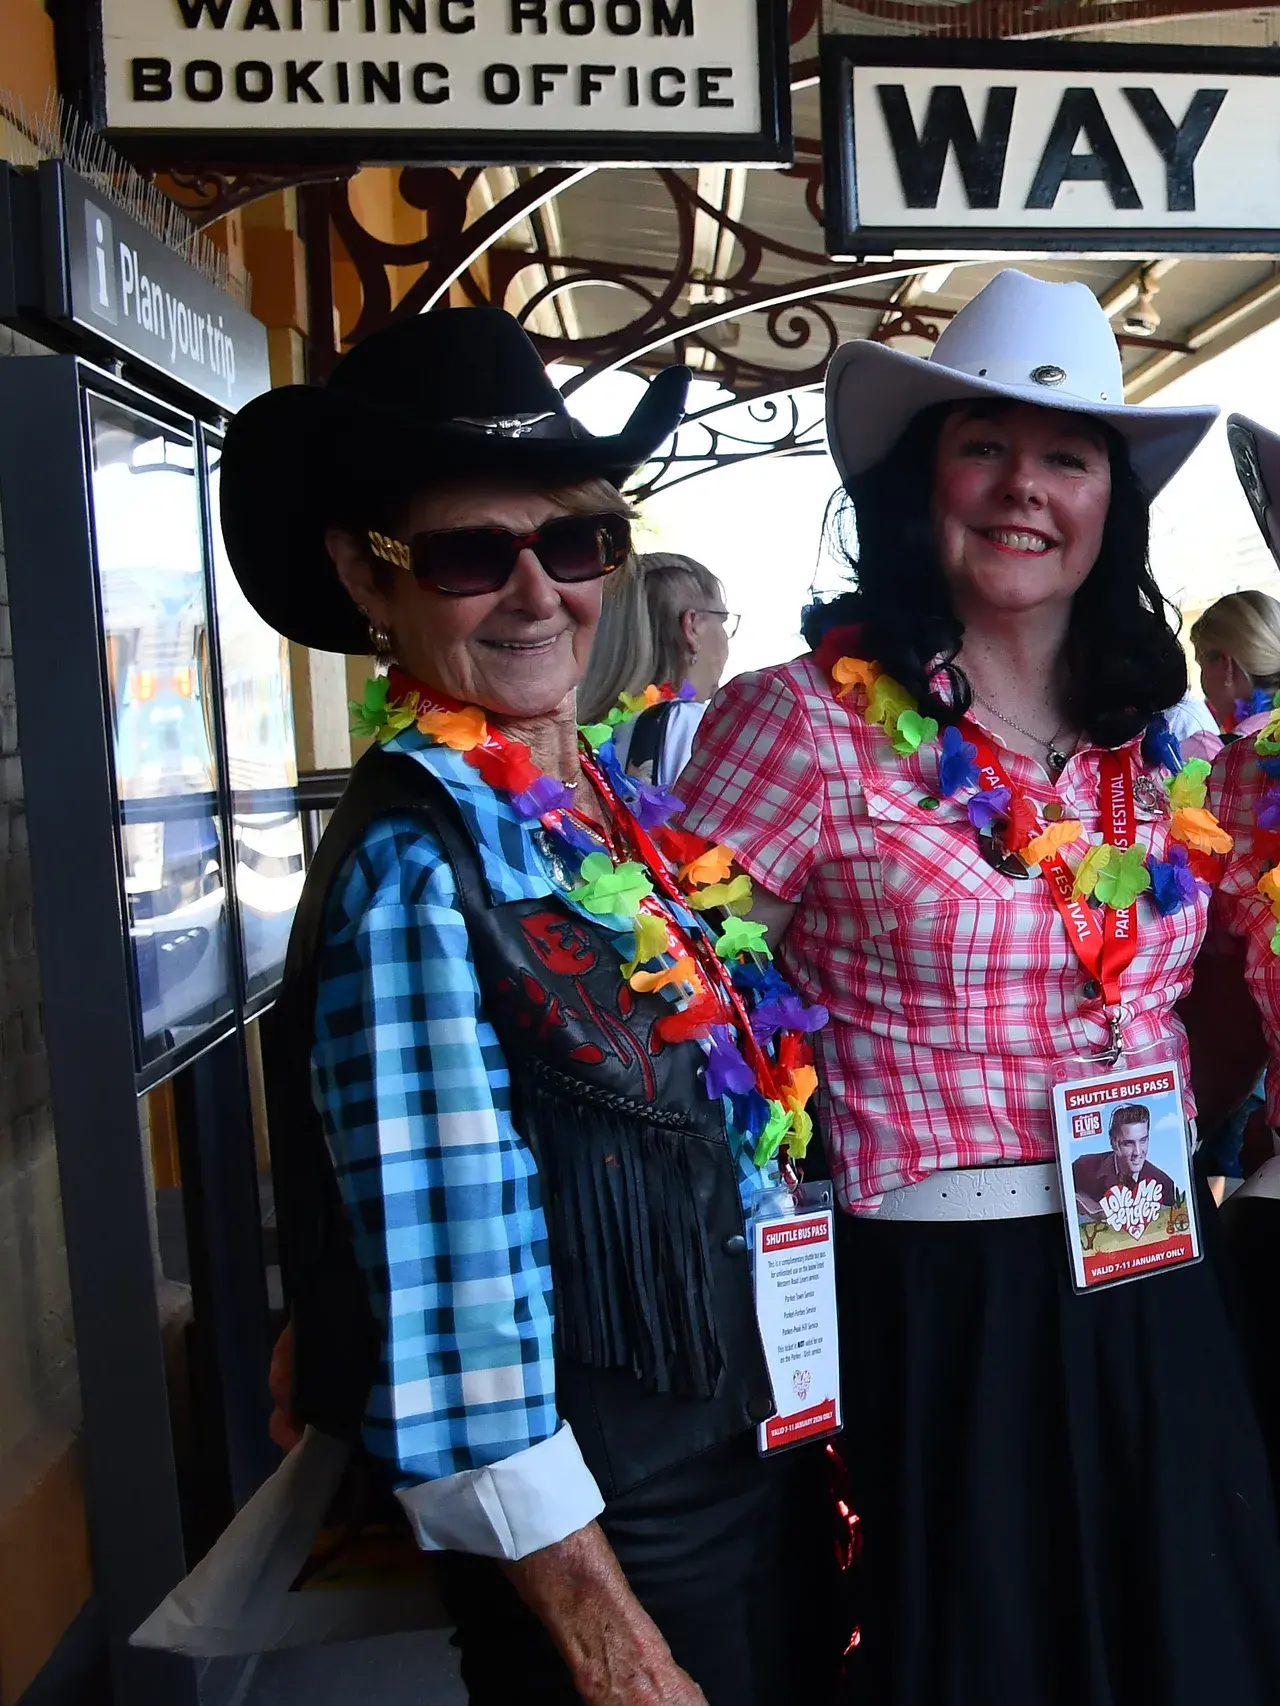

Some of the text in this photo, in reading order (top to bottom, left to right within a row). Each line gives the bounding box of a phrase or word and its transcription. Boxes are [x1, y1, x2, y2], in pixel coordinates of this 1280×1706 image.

[176, 0, 695, 37] WAITING ROOM
[131, 58, 735, 108] BOOKING OFFICE
[874, 83, 1230, 213] WAY
[120, 241, 236, 399] Plan your trip
[1110, 773, 1127, 834] FESTIVAL
[1070, 1078, 1169, 1107] SHUTTLE BUS PASS
[1074, 1116, 1100, 1133] ELVIS
[766, 1224, 827, 1246] SHUTTLE BUS PASS
[1091, 1247, 1186, 1277] VALID 7-11 JANUARY ONLY
[785, 1295, 795, 1303] Parkes
[804, 1291, 815, 1299] Service
[806, 1306, 816, 1314] Service
[808, 1322, 819, 1330] Service
[797, 1340, 805, 1348] NOT
[771, 1427, 784, 1437] VALID
[784, 1424, 795, 1433] 7-11
[795, 1418, 813, 1429] JANUARY
[822, 1411, 833, 1420] ONLY
